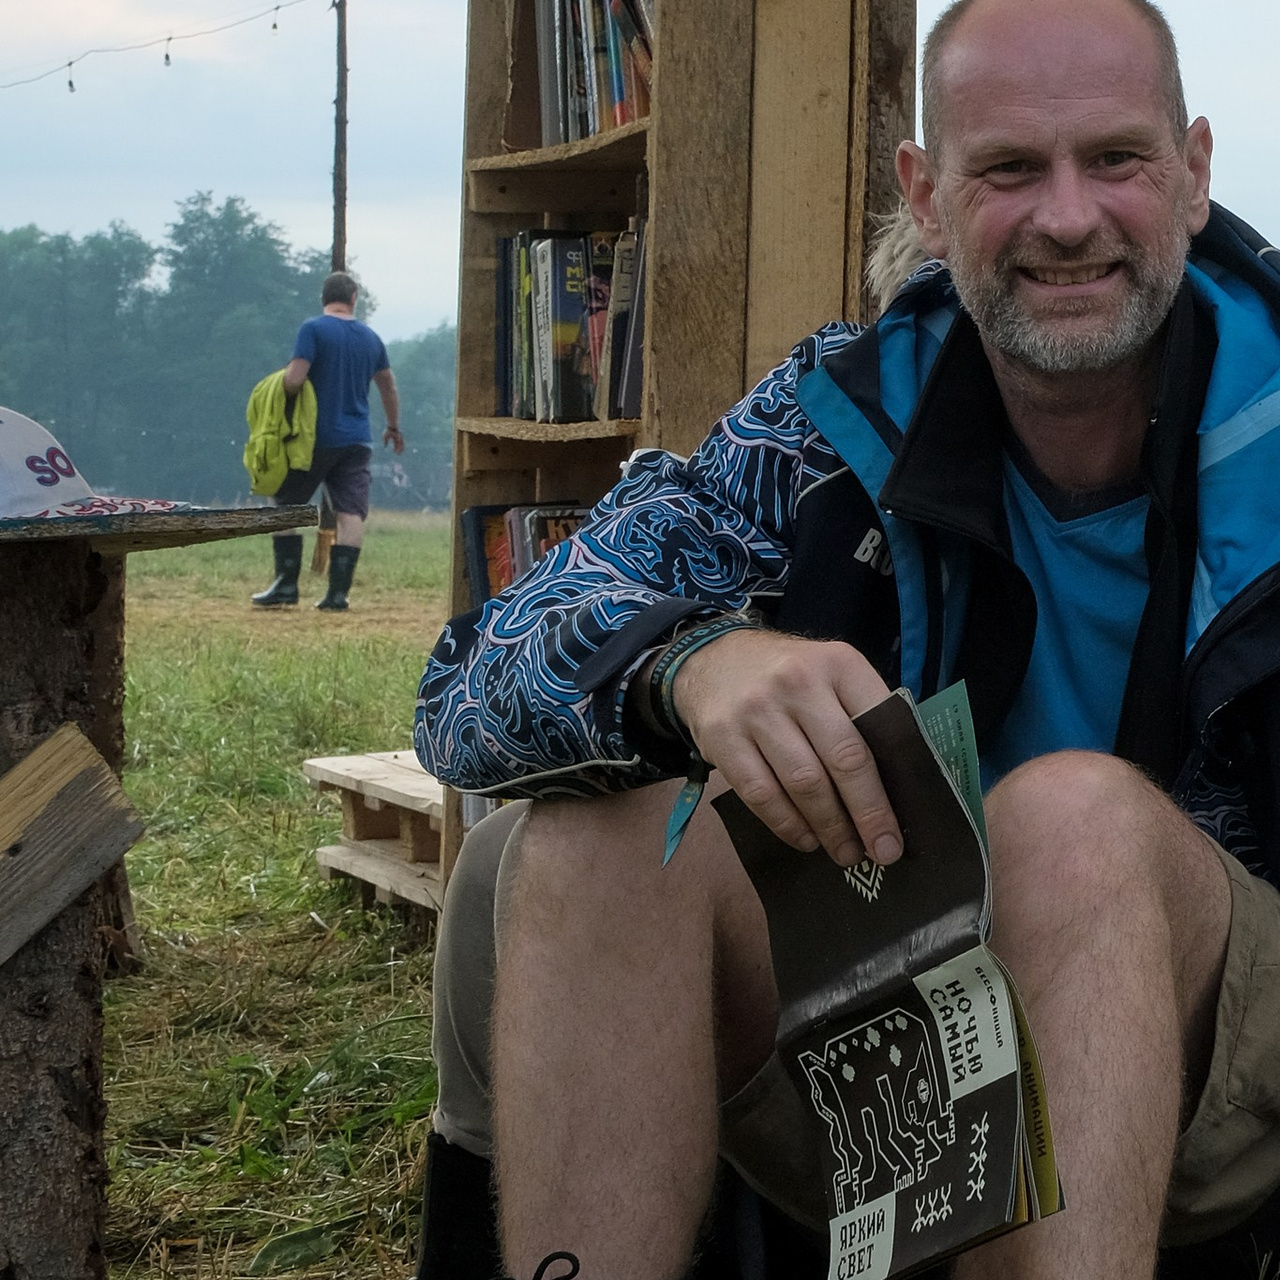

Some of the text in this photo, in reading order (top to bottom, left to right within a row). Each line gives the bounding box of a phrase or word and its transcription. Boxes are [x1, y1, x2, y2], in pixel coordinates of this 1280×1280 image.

[929, 988, 967, 1084] САМЫЙ
[945, 980, 983, 1074] НОЧЬЮ
[840, 1208, 885, 1251] ЯРКИЙ
